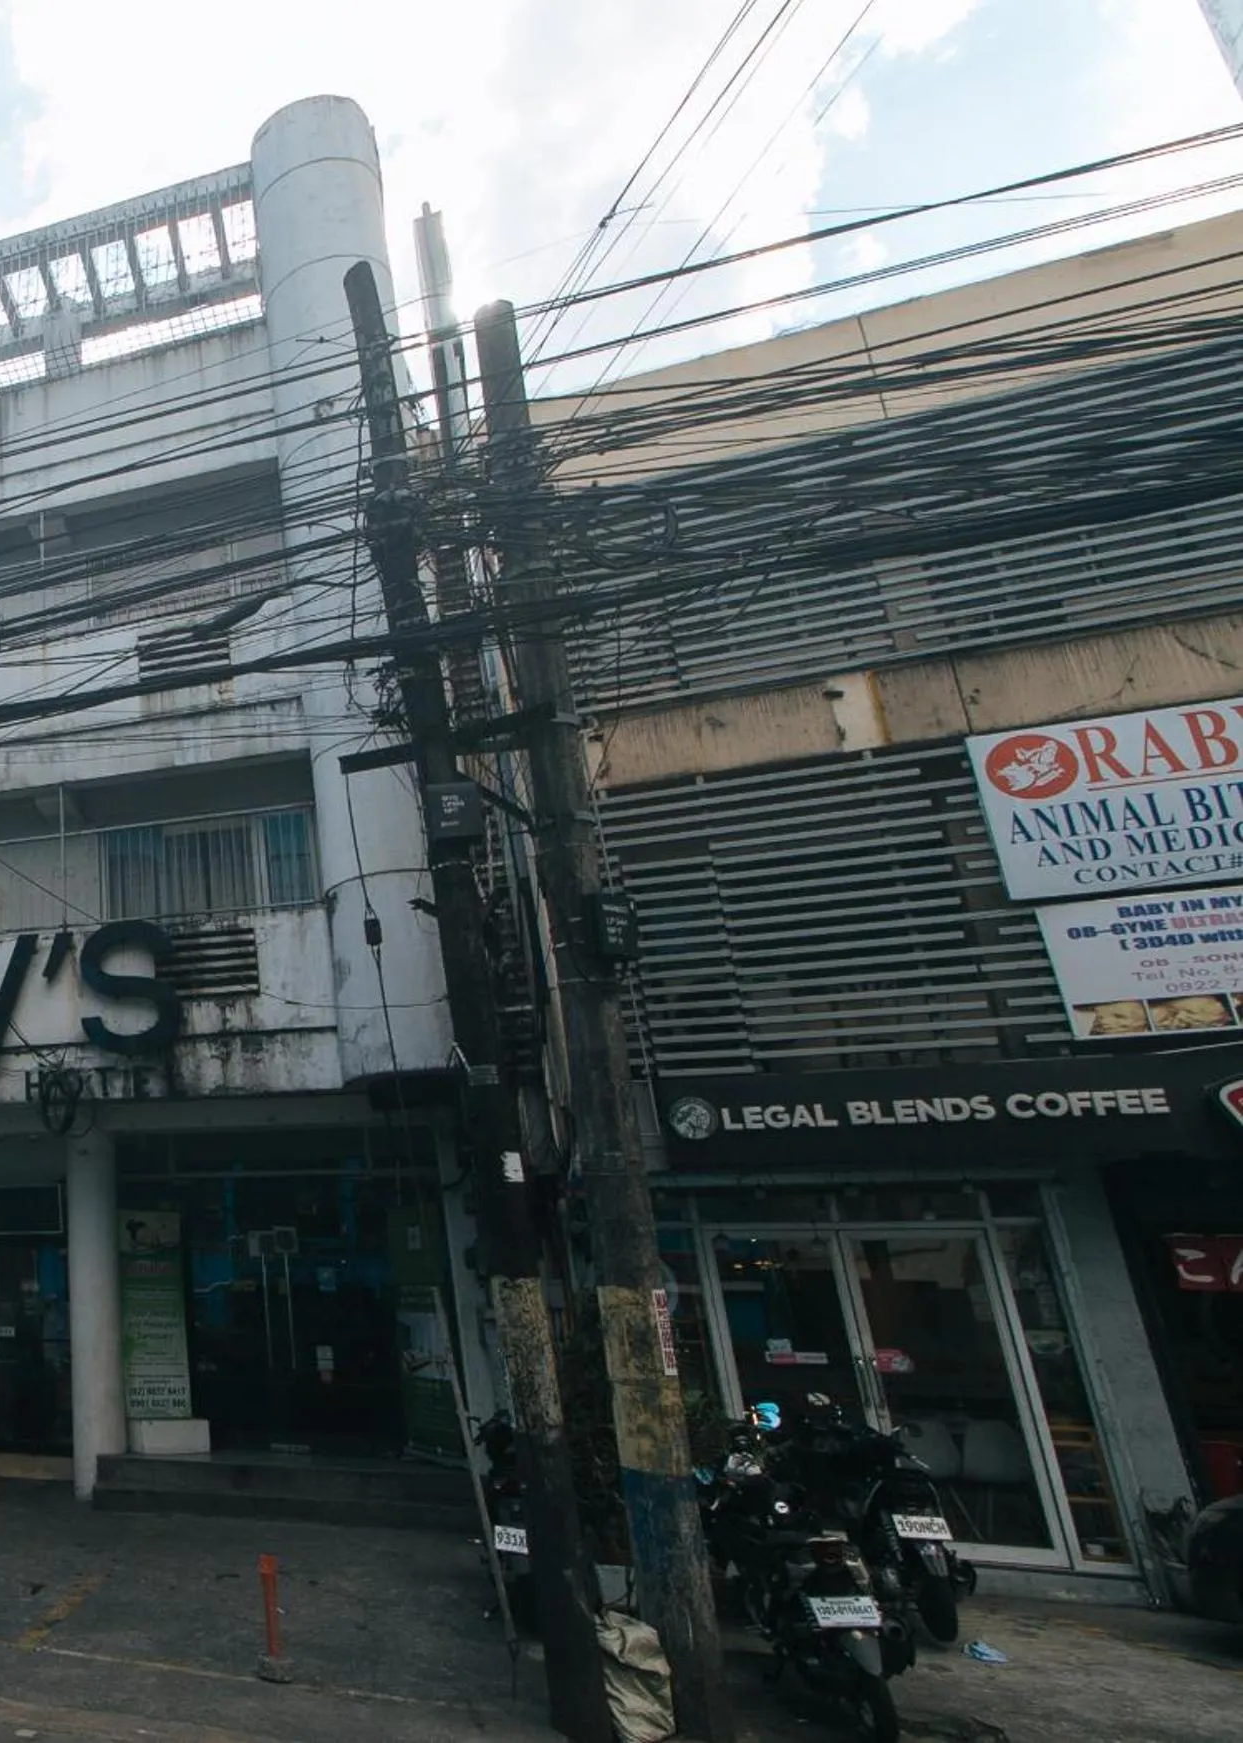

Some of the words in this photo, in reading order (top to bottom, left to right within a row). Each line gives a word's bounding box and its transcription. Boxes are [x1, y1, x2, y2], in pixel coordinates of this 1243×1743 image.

[1073, 706, 1243, 784] RAB
[1011, 792, 1175, 844] ANIMAL
[1038, 838, 1111, 867] AND
[1117, 901, 1175, 918] BABY
[1181, 899, 1205, 912] IN
[1170, 911, 1243, 929] ULTRA
[1192, 952, 1243, 963] SON
[721, 1103, 838, 1130] LEGAL
[847, 1095, 996, 1125] BLENDS
[1005, 1088, 1170, 1118] COFFEE
